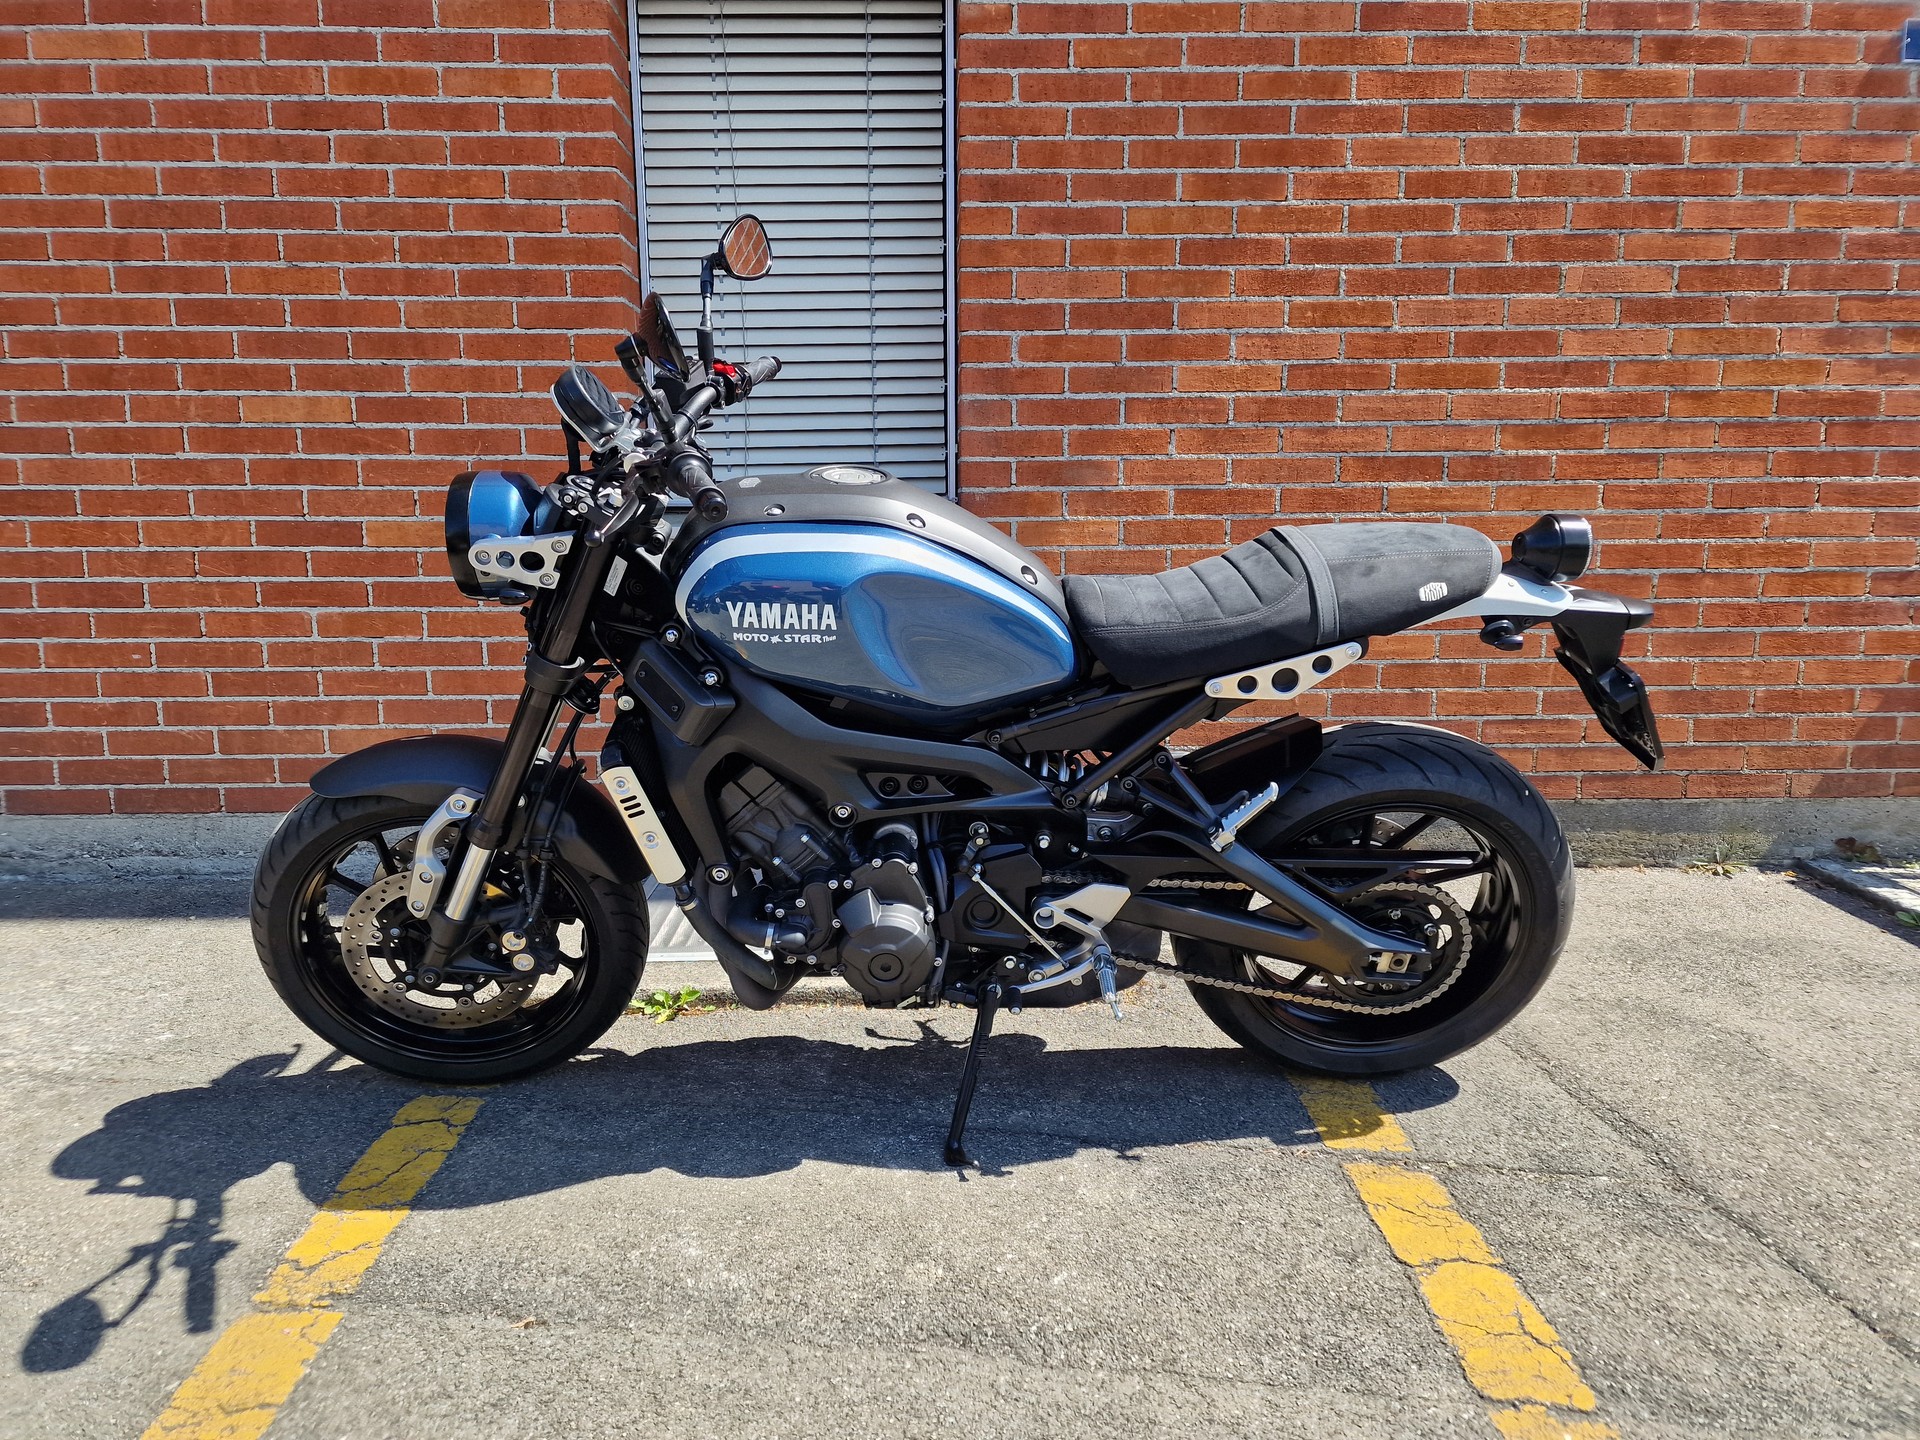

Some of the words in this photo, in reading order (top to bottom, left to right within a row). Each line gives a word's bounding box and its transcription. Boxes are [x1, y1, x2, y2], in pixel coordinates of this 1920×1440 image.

[725, 601, 837, 630] YAMAHA
[733, 632, 769, 642] MOTO
[784, 634, 822, 643] STAR
